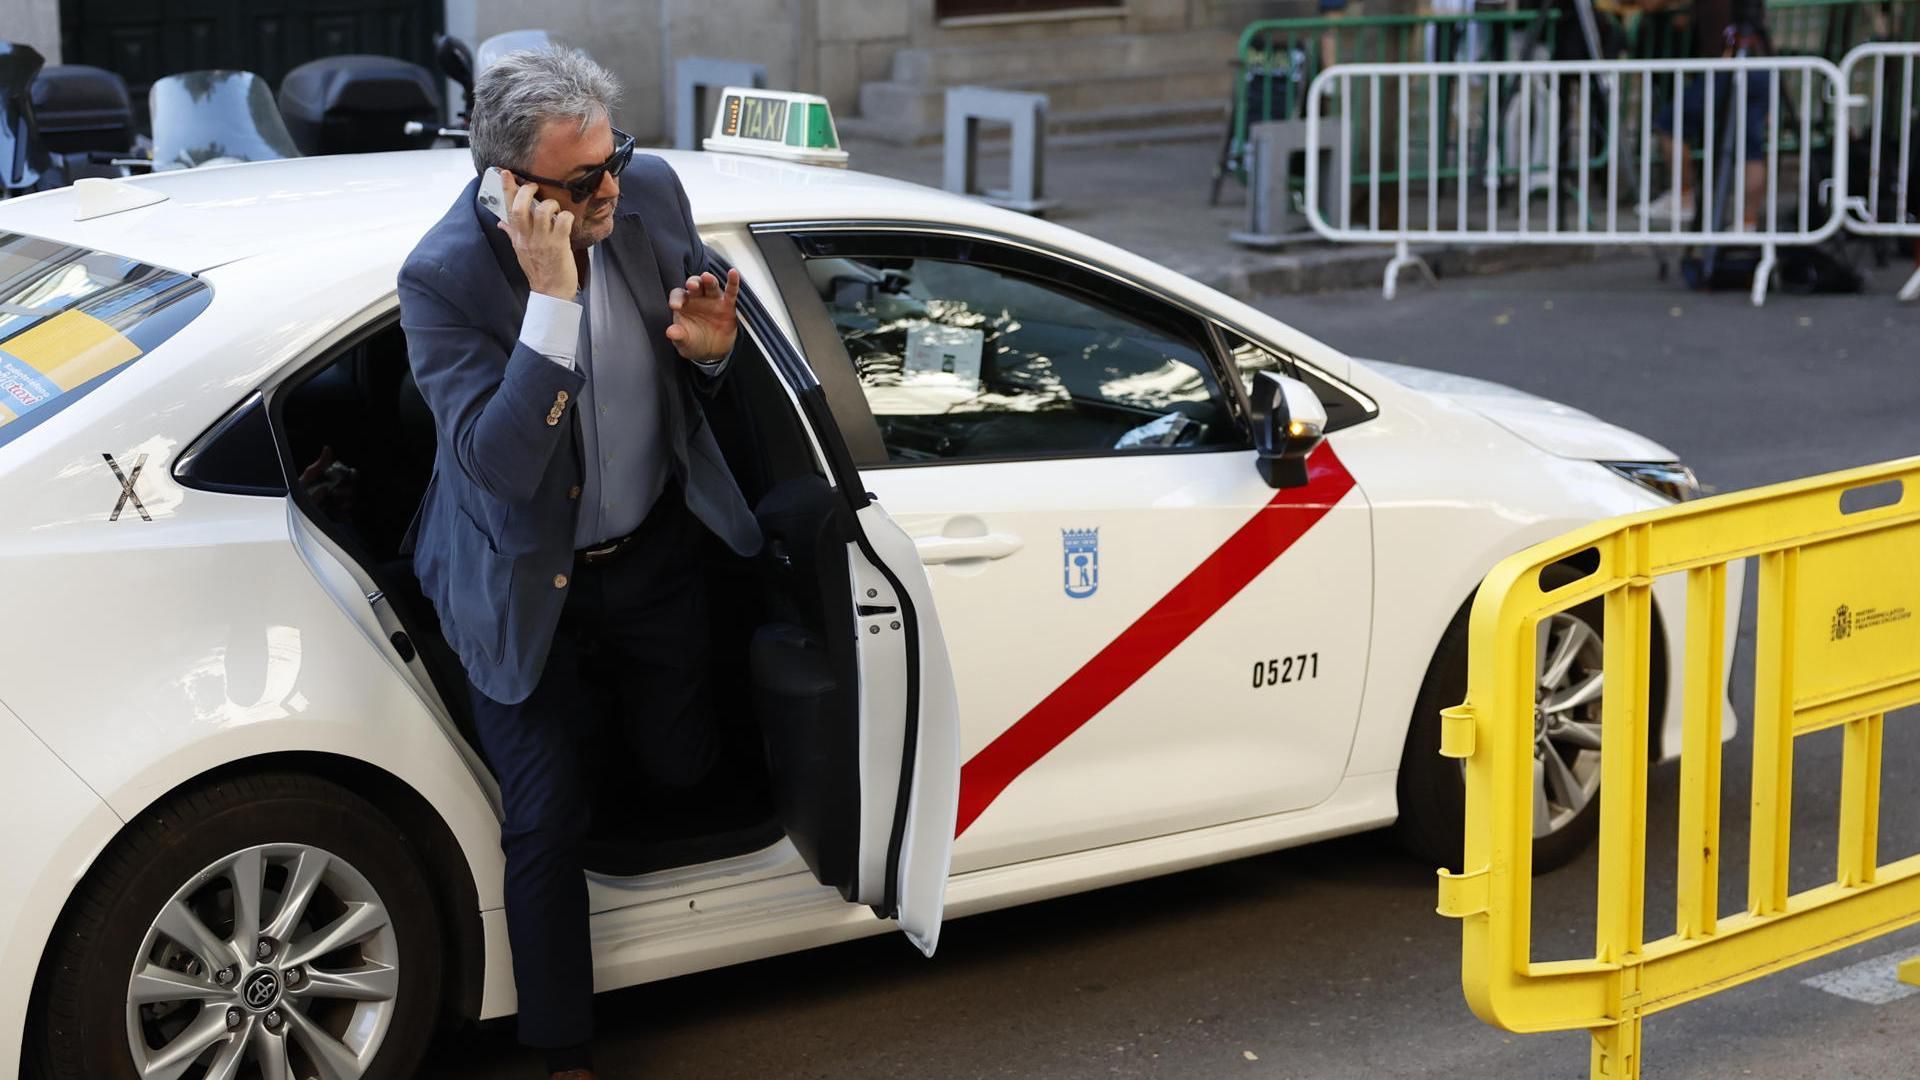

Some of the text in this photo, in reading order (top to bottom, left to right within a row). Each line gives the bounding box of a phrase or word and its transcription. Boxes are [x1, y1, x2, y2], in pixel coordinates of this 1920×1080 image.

[744, 99, 785, 140] TAXI
[102, 453, 153, 522] X
[1253, 652, 1318, 688] 05271
